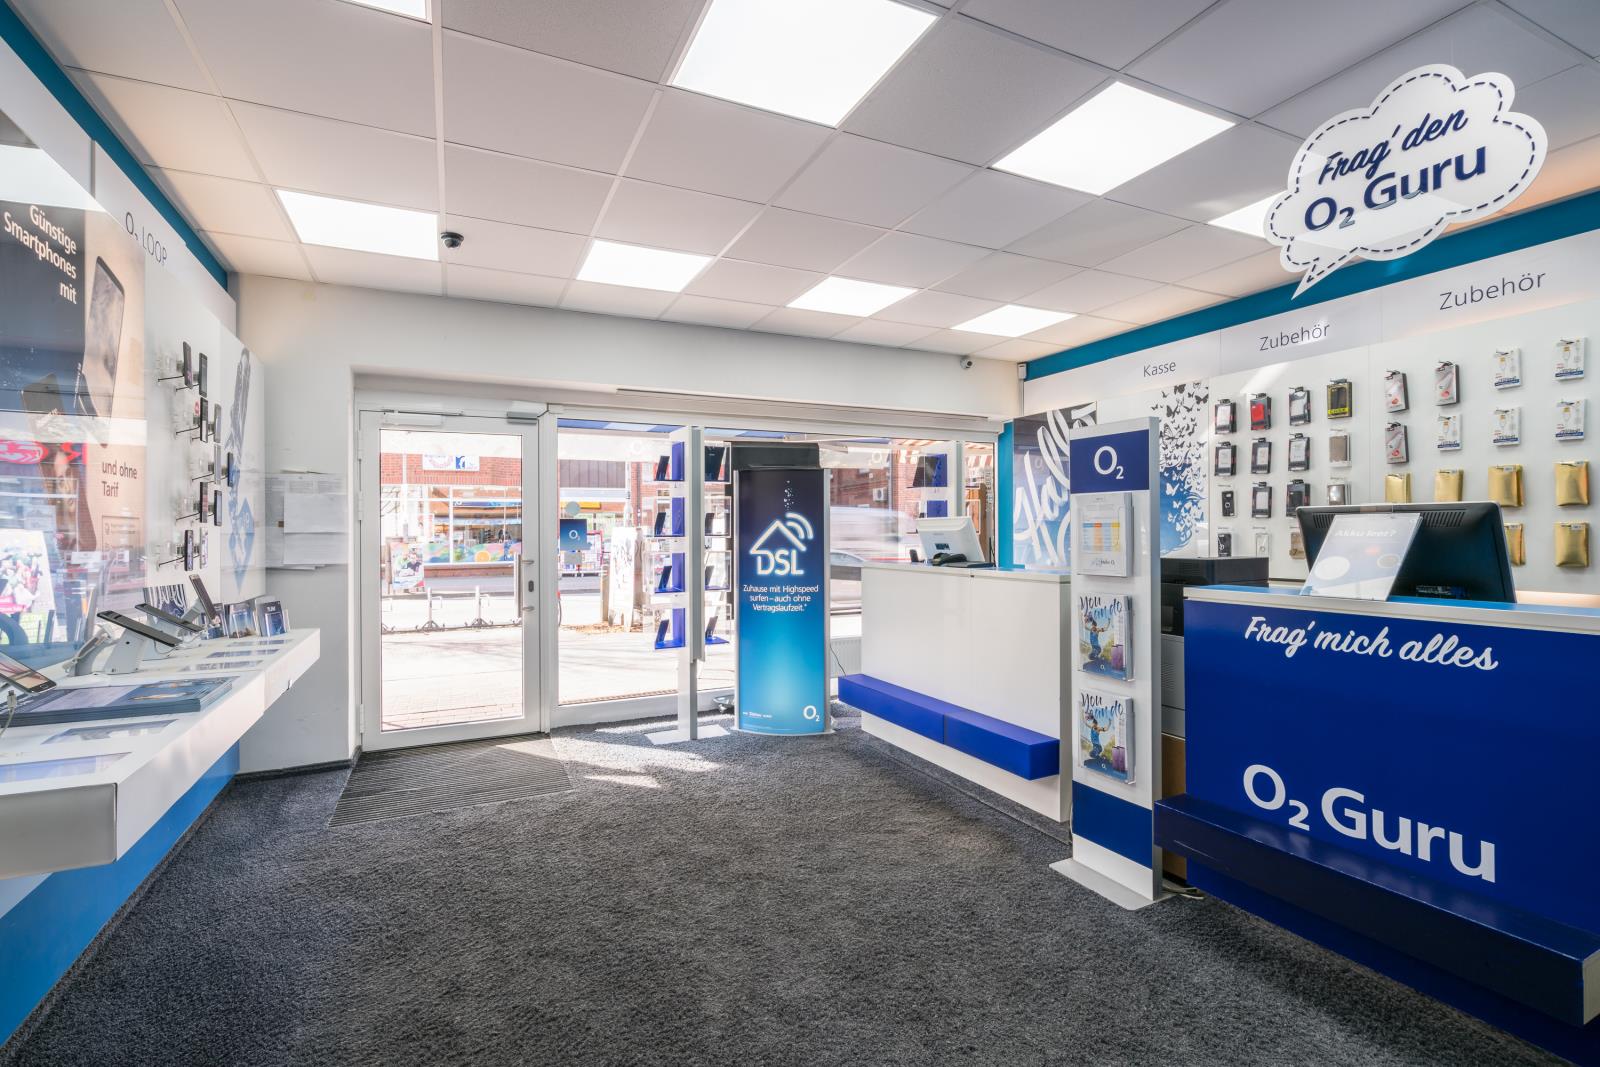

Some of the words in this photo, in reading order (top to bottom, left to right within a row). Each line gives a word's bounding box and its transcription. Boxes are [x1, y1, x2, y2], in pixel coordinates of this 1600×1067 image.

[1318, 124, 1401, 185] Frag'
[1402, 108, 1468, 153] den
[1363, 146, 1487, 211] Guru
[29, 204, 78, 255] Günstige
[3, 210, 78, 279] Smartphones
[142, 225, 168, 265] LOOP
[59, 281, 78, 305] mit
[1439, 271, 1547, 310] Zubehör
[1259, 321, 1331, 351] Zubehör
[1143, 359, 1176, 378] Kasse
[101, 458, 117, 476] und
[119, 462, 138, 480] ohne
[101, 480, 119, 498] Tarif
[755, 549, 804, 577] DSL
[743, 584, 768, 593] Zuhause
[769, 584, 781, 593] mit
[782, 584, 819, 595] Highspeed
[750, 594, 769, 602] surfen
[774, 594, 791, 602] auch
[1080, 596, 1101, 617] You
[1244, 615, 1315, 659] Frag'
[1314, 627, 1393, 659] mich
[1399, 633, 1499, 671] alles
[1081, 692, 1102, 714] You
[1320, 786, 1497, 884] Guru
